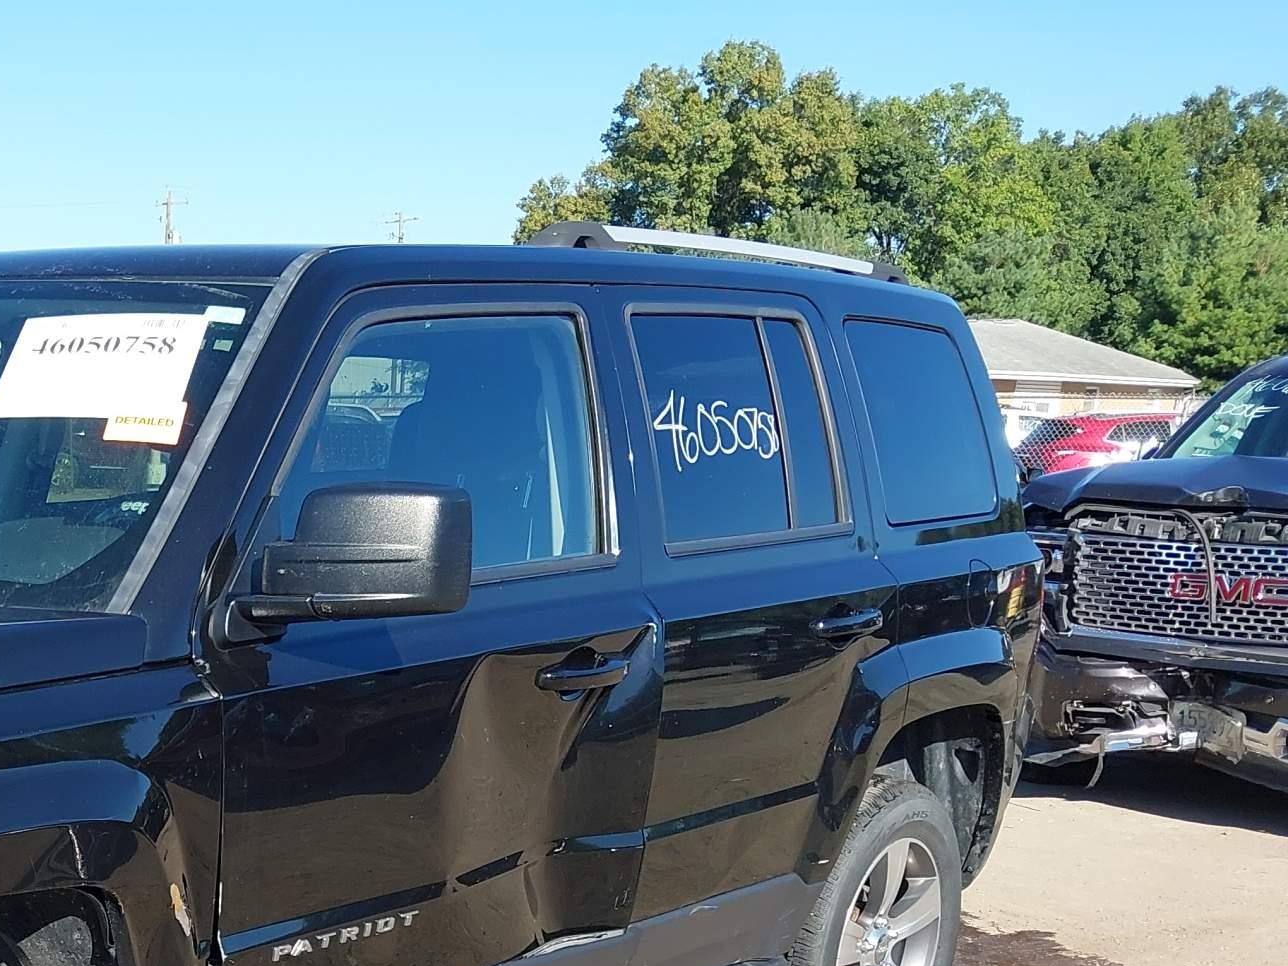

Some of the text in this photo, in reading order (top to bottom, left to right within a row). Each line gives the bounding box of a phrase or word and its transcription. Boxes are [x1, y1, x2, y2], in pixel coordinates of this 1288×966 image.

[32, 335, 177, 356] 46050758
[114, 416, 175, 427] DETAILED
[1169, 573, 1288, 606] GMC
[271, 910, 420, 962] PATRIOT
